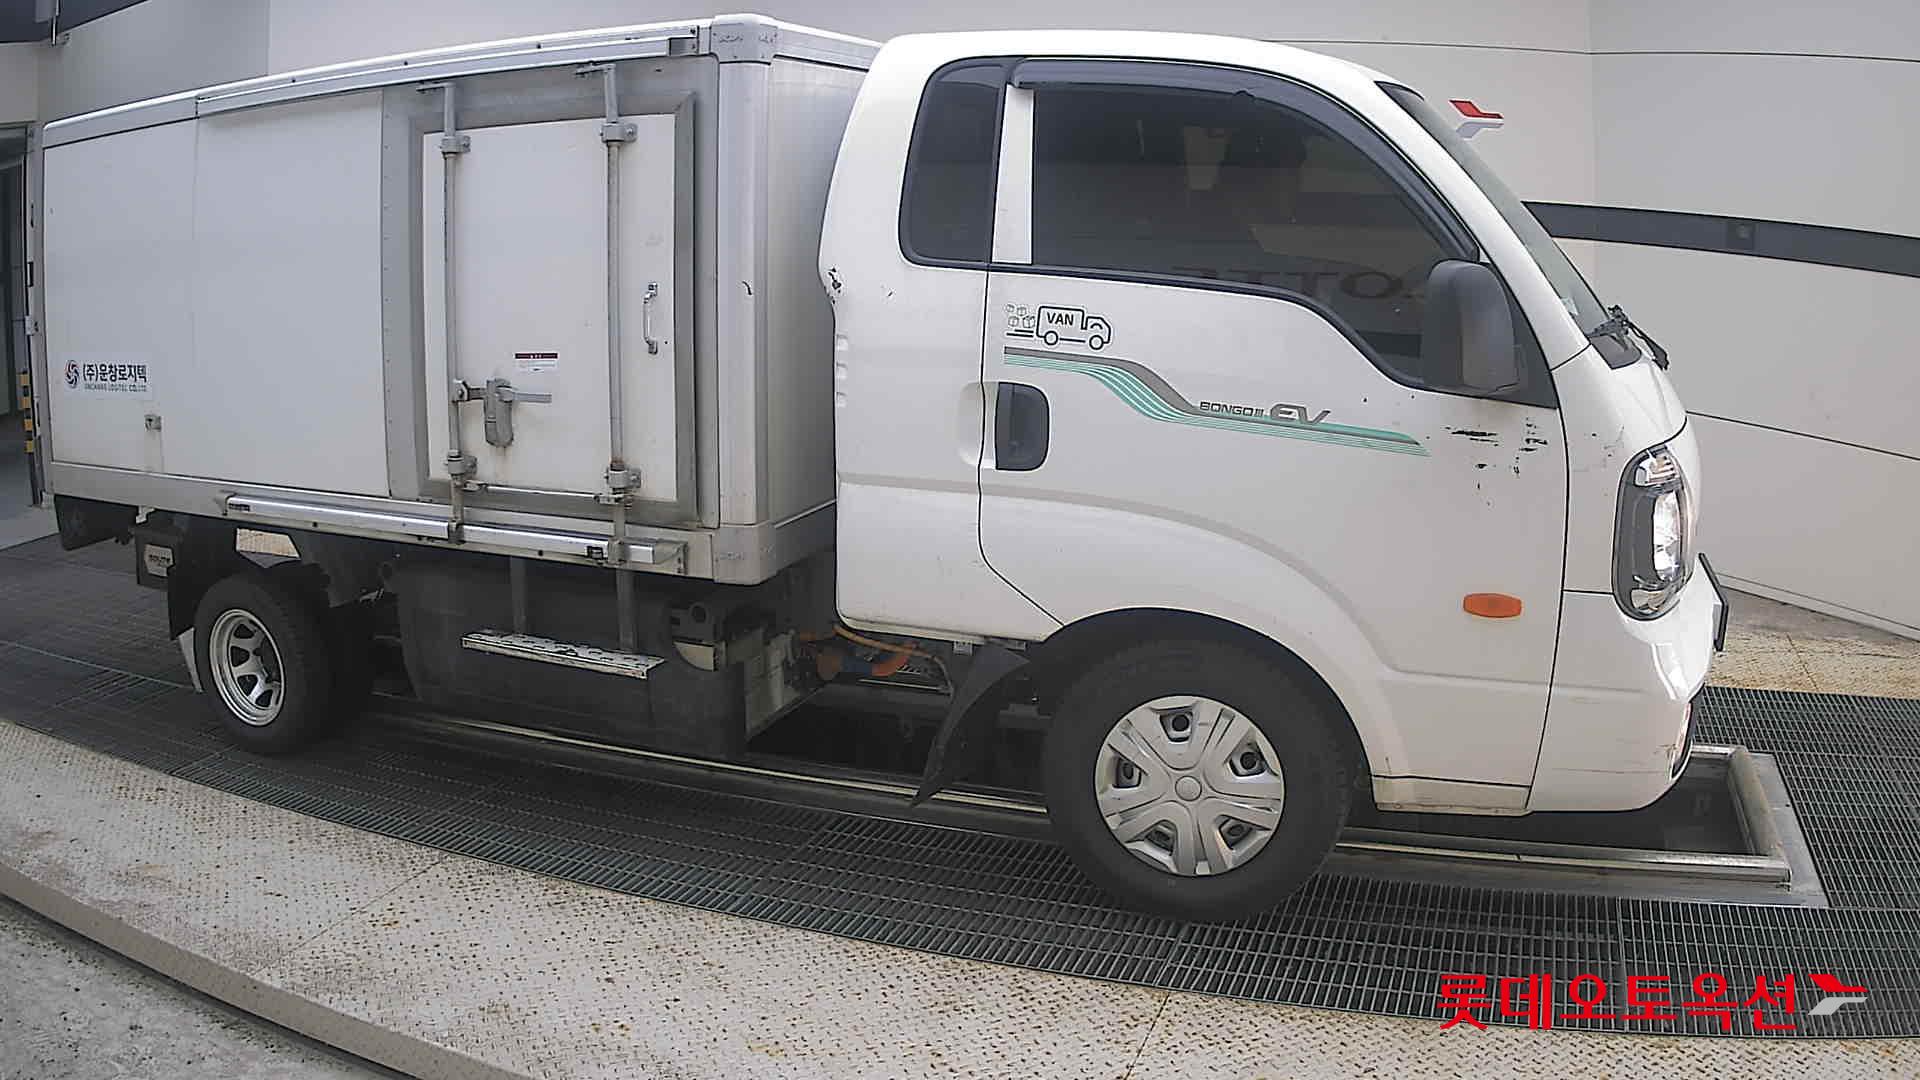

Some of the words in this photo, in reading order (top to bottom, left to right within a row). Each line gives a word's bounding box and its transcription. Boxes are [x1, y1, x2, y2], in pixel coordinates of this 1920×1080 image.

[1047, 311, 1074, 326] VAN
[82, 363, 147, 383] (주)운창로지텍
[1270, 403, 1331, 425] EV
